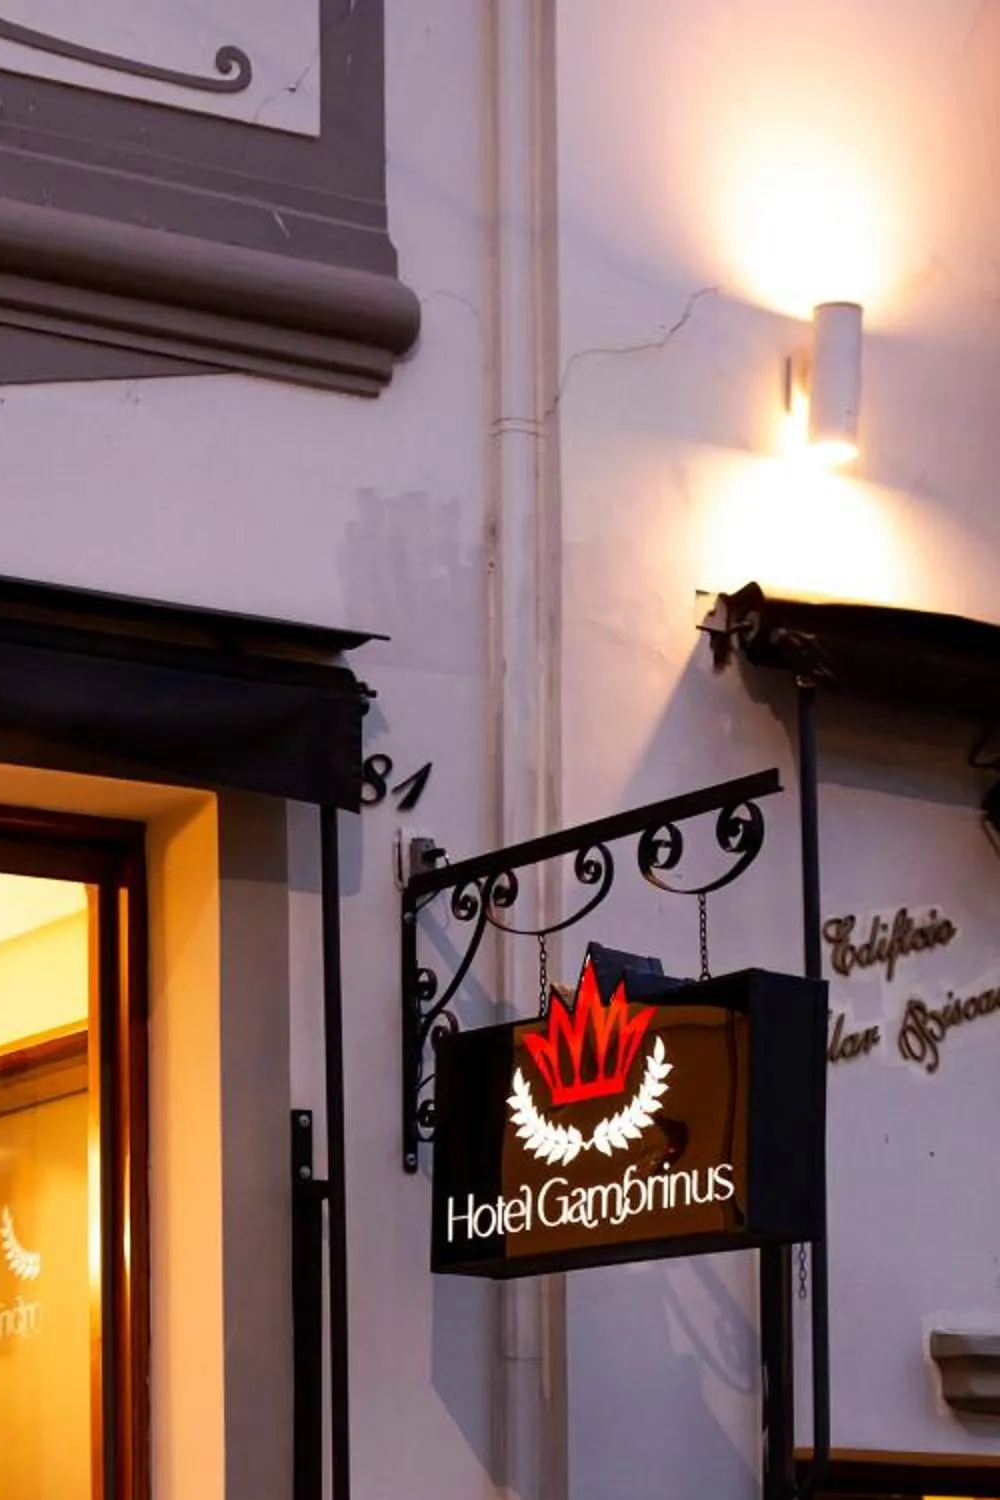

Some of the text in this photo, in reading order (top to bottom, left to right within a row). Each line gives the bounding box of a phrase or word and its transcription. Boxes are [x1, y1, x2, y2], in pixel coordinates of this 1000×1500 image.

[828, 1009, 881, 1063] lar
[447, 1163, 735, 1242] Hotel Gambrinus
